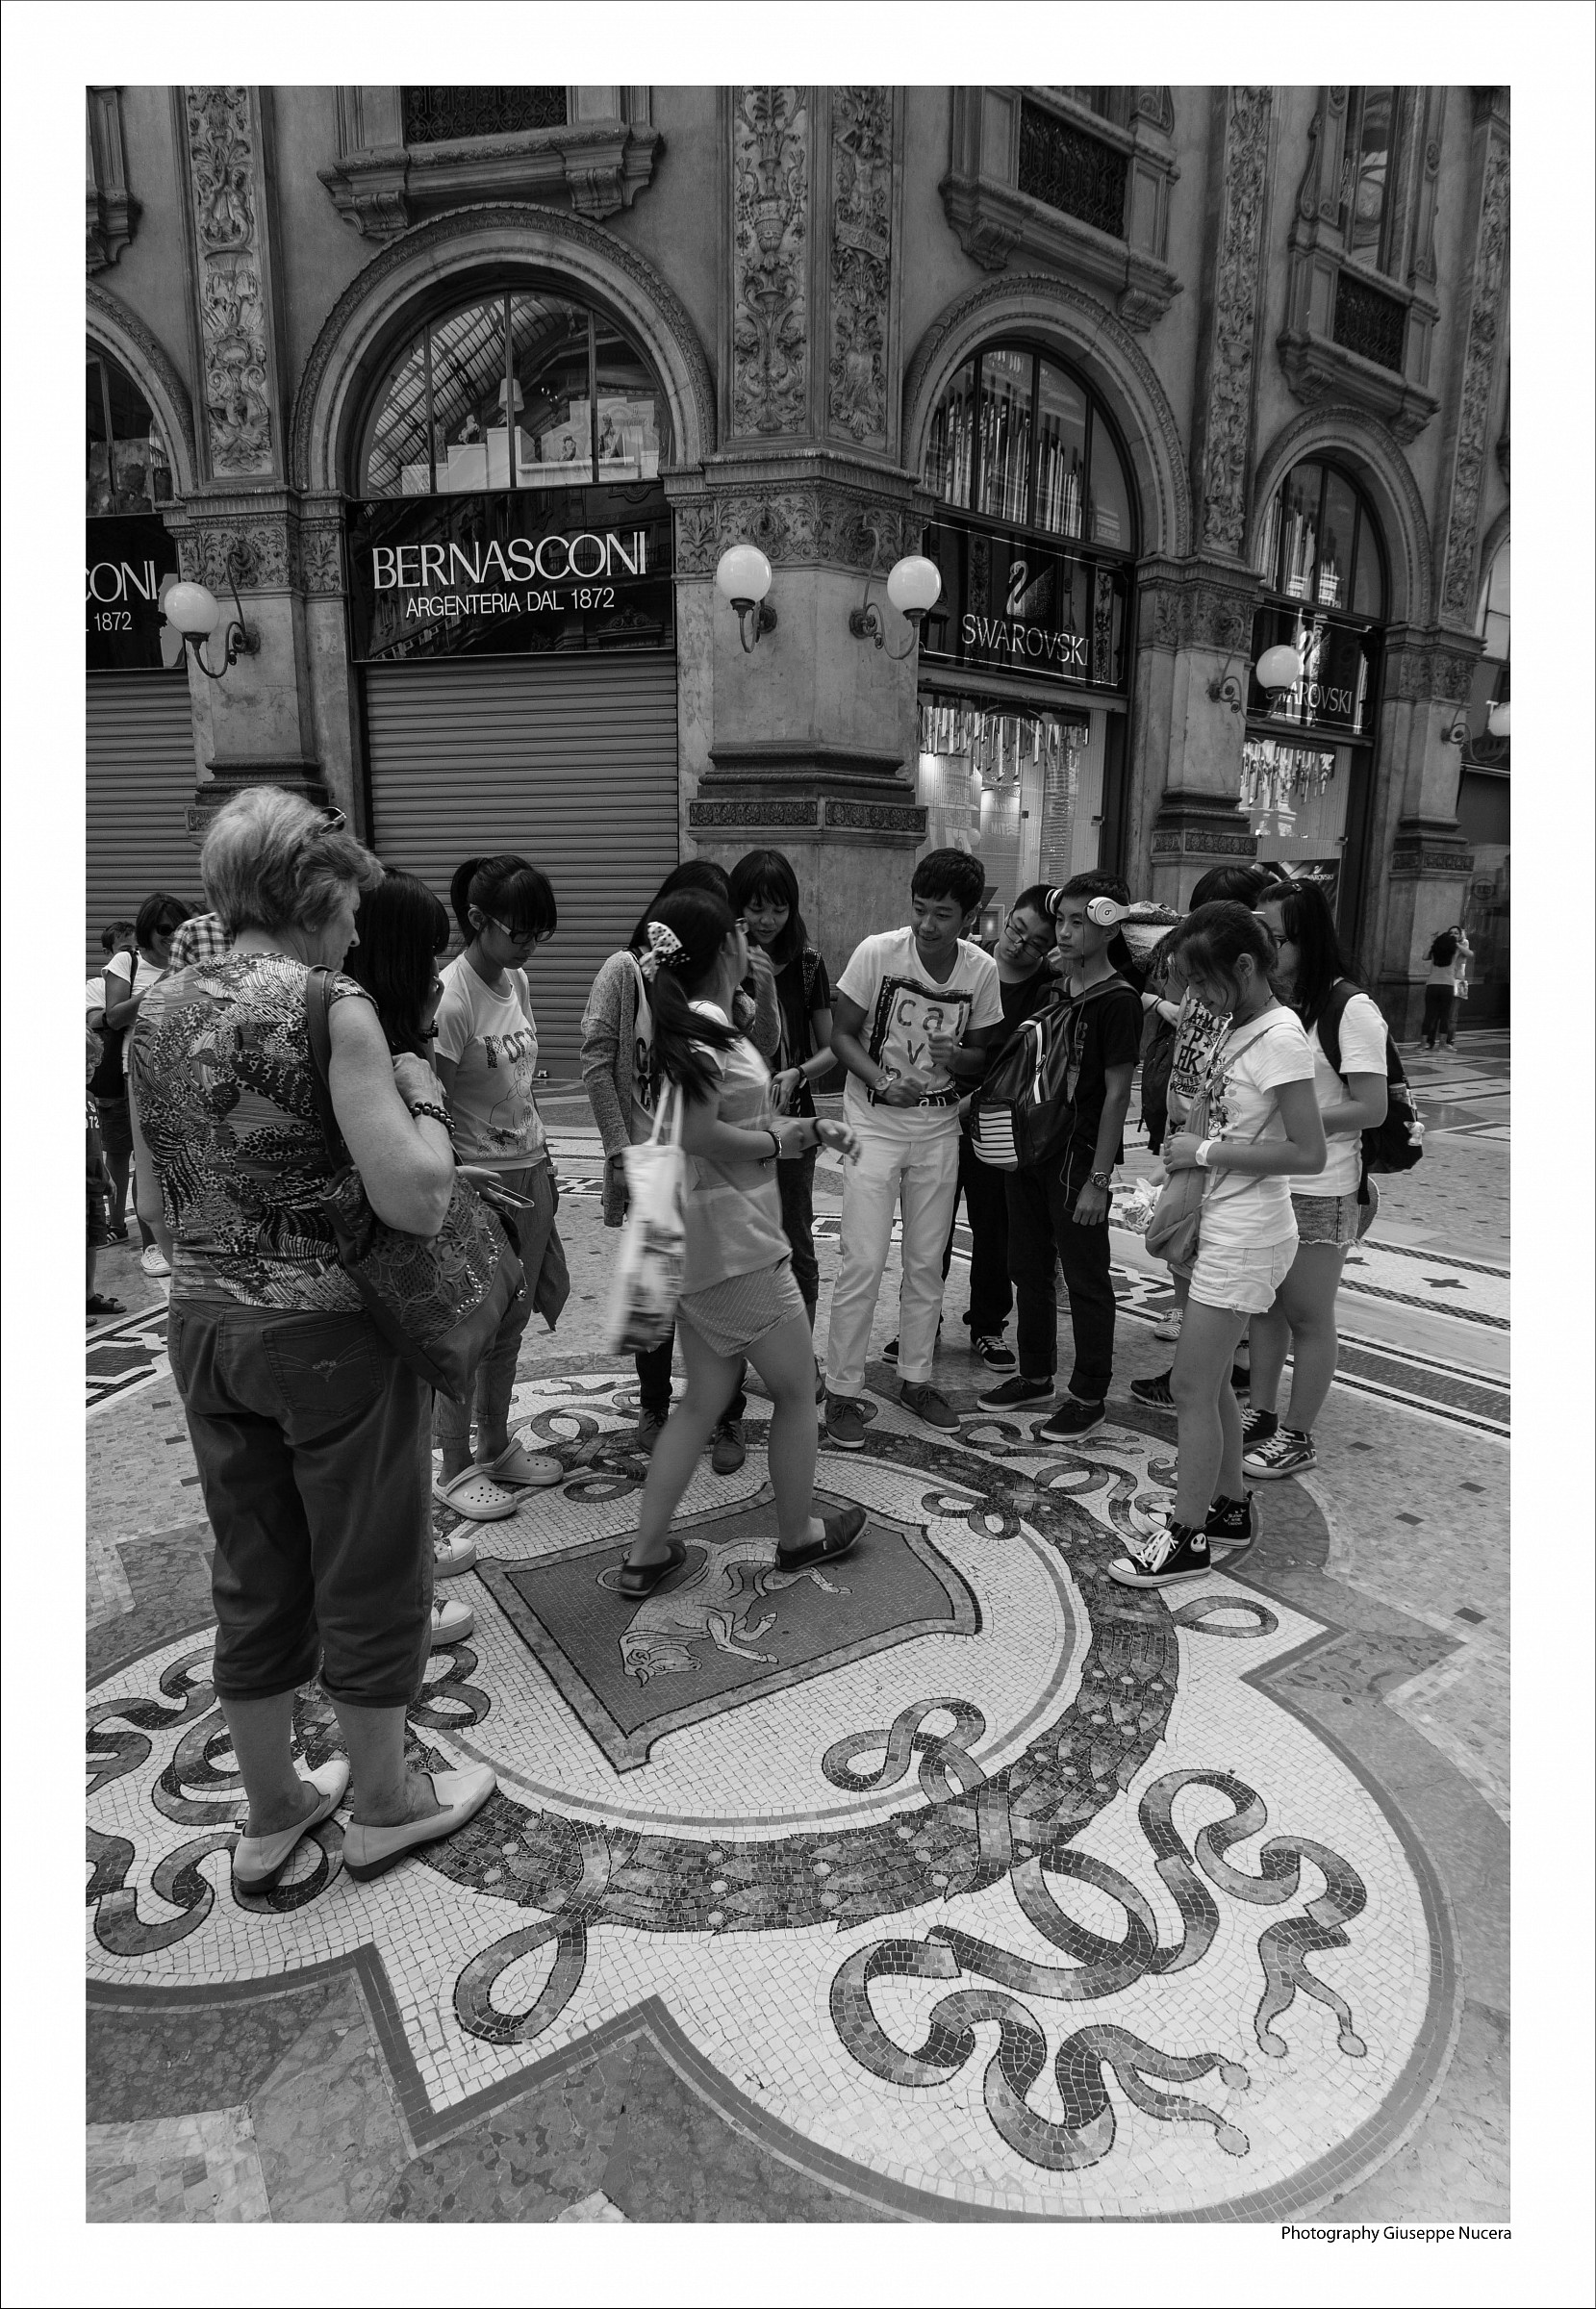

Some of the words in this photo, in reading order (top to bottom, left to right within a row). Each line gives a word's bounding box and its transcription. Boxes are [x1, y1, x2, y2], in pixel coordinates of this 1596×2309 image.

[372, 531, 646, 589] BERNASCONI
[406, 592, 521, 618] ARGENTERIA
[527, 590, 565, 612] DAL
[570, 587, 615, 609] 1872
[94, 611, 133, 632] 1872
[962, 614, 1090, 666] SWAROVSKI
[1266, 680, 1353, 714] AROVSKI
